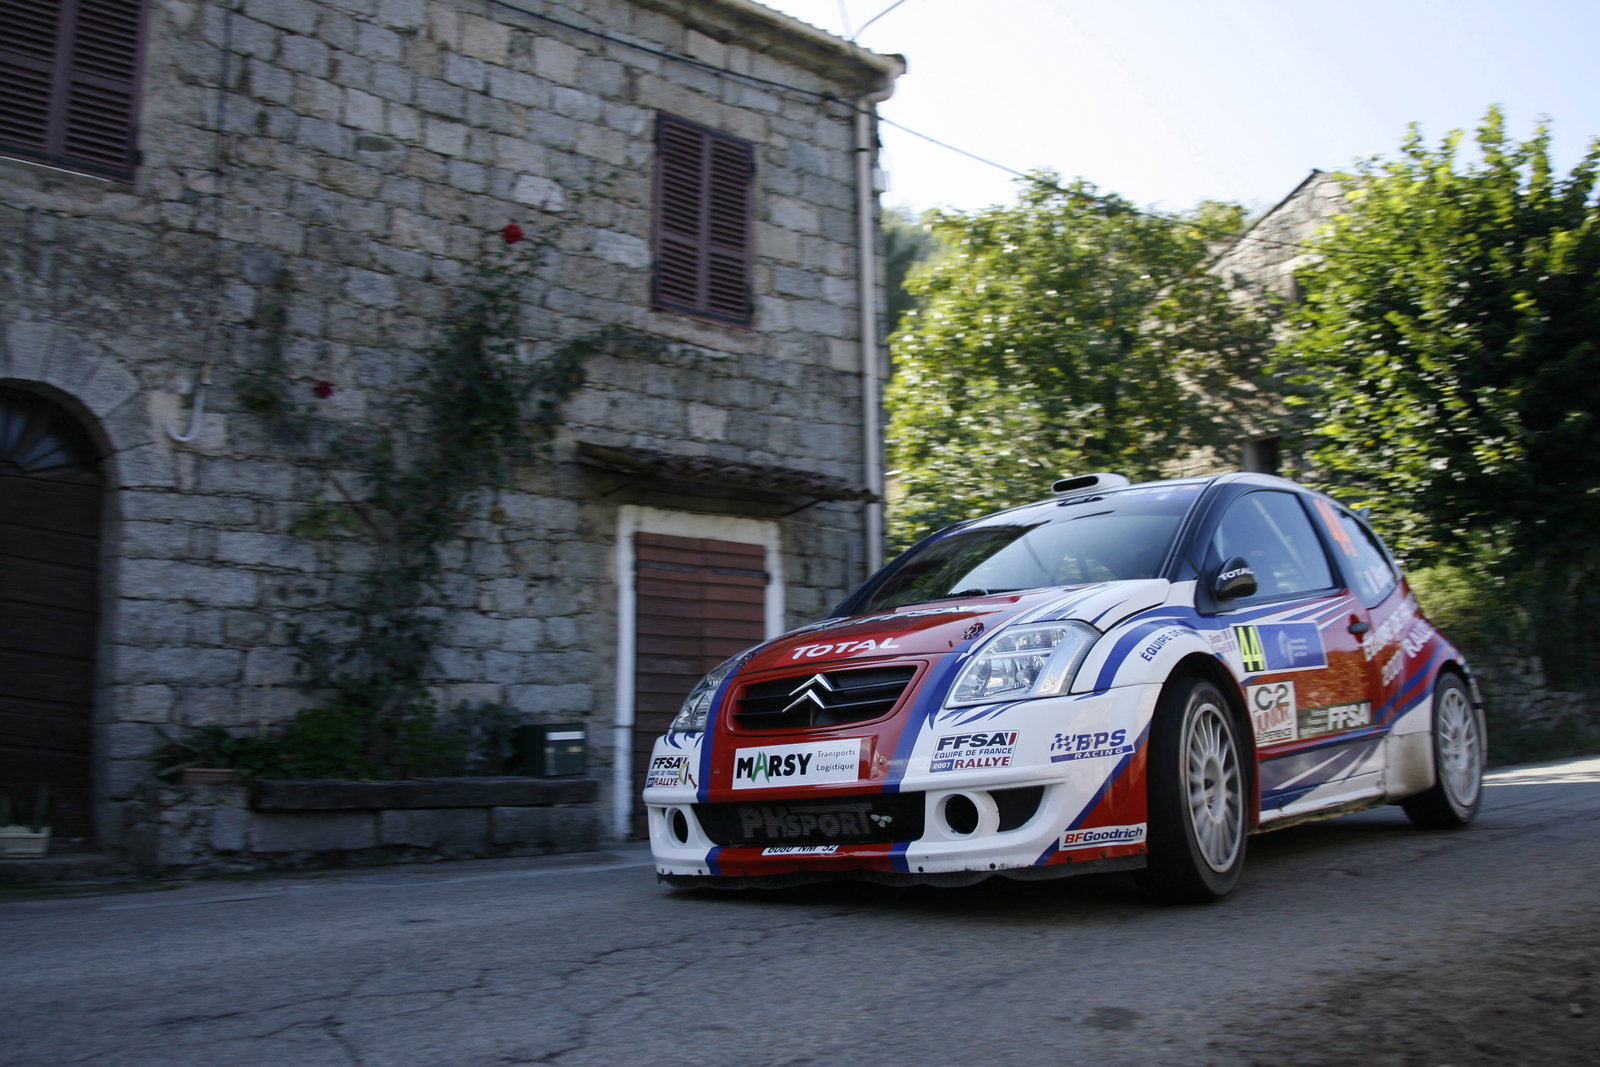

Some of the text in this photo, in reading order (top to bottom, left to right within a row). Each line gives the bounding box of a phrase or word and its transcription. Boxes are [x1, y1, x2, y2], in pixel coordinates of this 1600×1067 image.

[1217, 567, 1255, 581] TOTAL
[792, 637, 900, 660] TOTAL
[1237, 626, 1265, 672] 44
[1255, 684, 1290, 711] C2
[1327, 703, 1369, 731] FFSA
[937, 732, 1008, 751] FFSA
[1076, 729, 1126, 751] BPS
[817, 748, 855, 758] Transports
[1074, 747, 1123, 759] RACING
[652, 757, 682, 769] FFSA
[736, 751, 813, 783] MARSY
[816, 763, 855, 773] Logistique
[954, 757, 1010, 769] RALLYE
[654, 777, 679, 786] RALLYE
[1064, 827, 1143, 844] BFGoodrich
